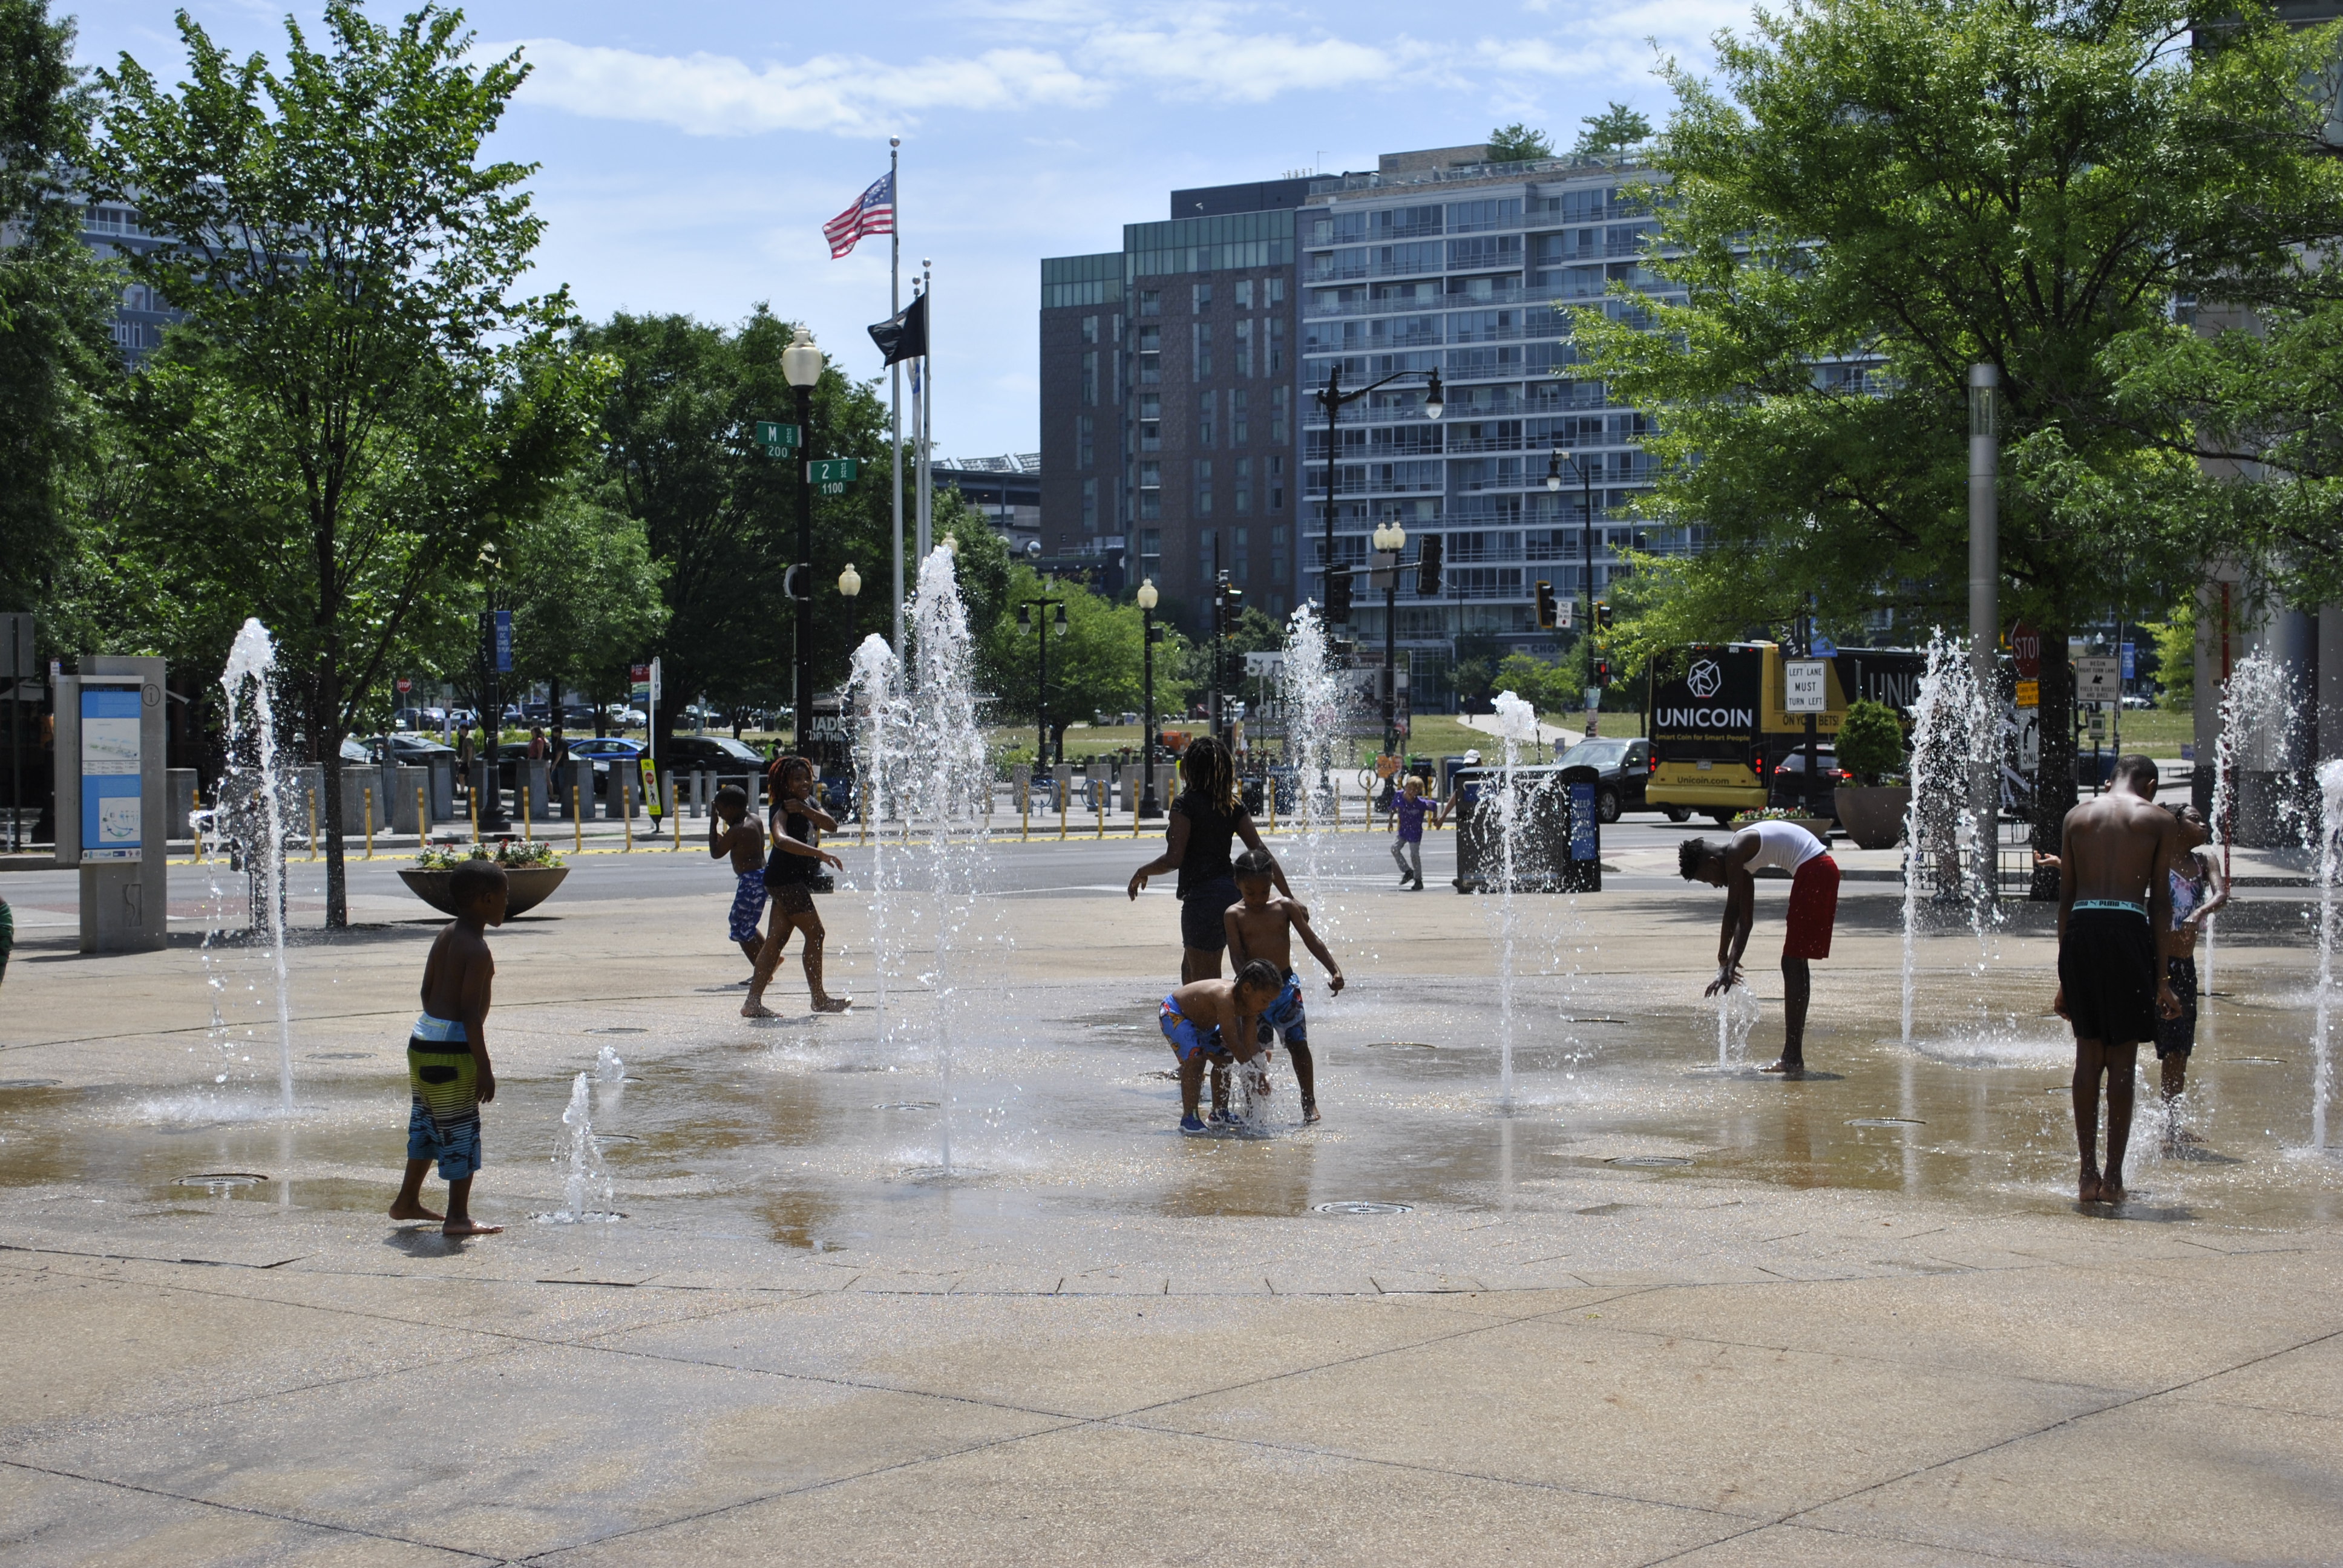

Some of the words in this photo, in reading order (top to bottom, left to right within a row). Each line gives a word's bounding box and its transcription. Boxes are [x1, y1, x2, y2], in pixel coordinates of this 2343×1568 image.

[768, 425, 777, 442] M
[768, 445, 788, 458] 200
[821, 463, 830, 480] 2
[822, 482, 844, 495] 1100
[1781, 625, 1799, 656] NAVY
[1795, 682, 1816, 691] MUST
[1657, 708, 1752, 727] UNICOIN
[1783, 715, 1795, 725] ON
[1818, 715, 1839, 725] BETS!
[2023, 753, 2039, 764] ONL
[1677, 776, 1729, 785] Unicoin.com
